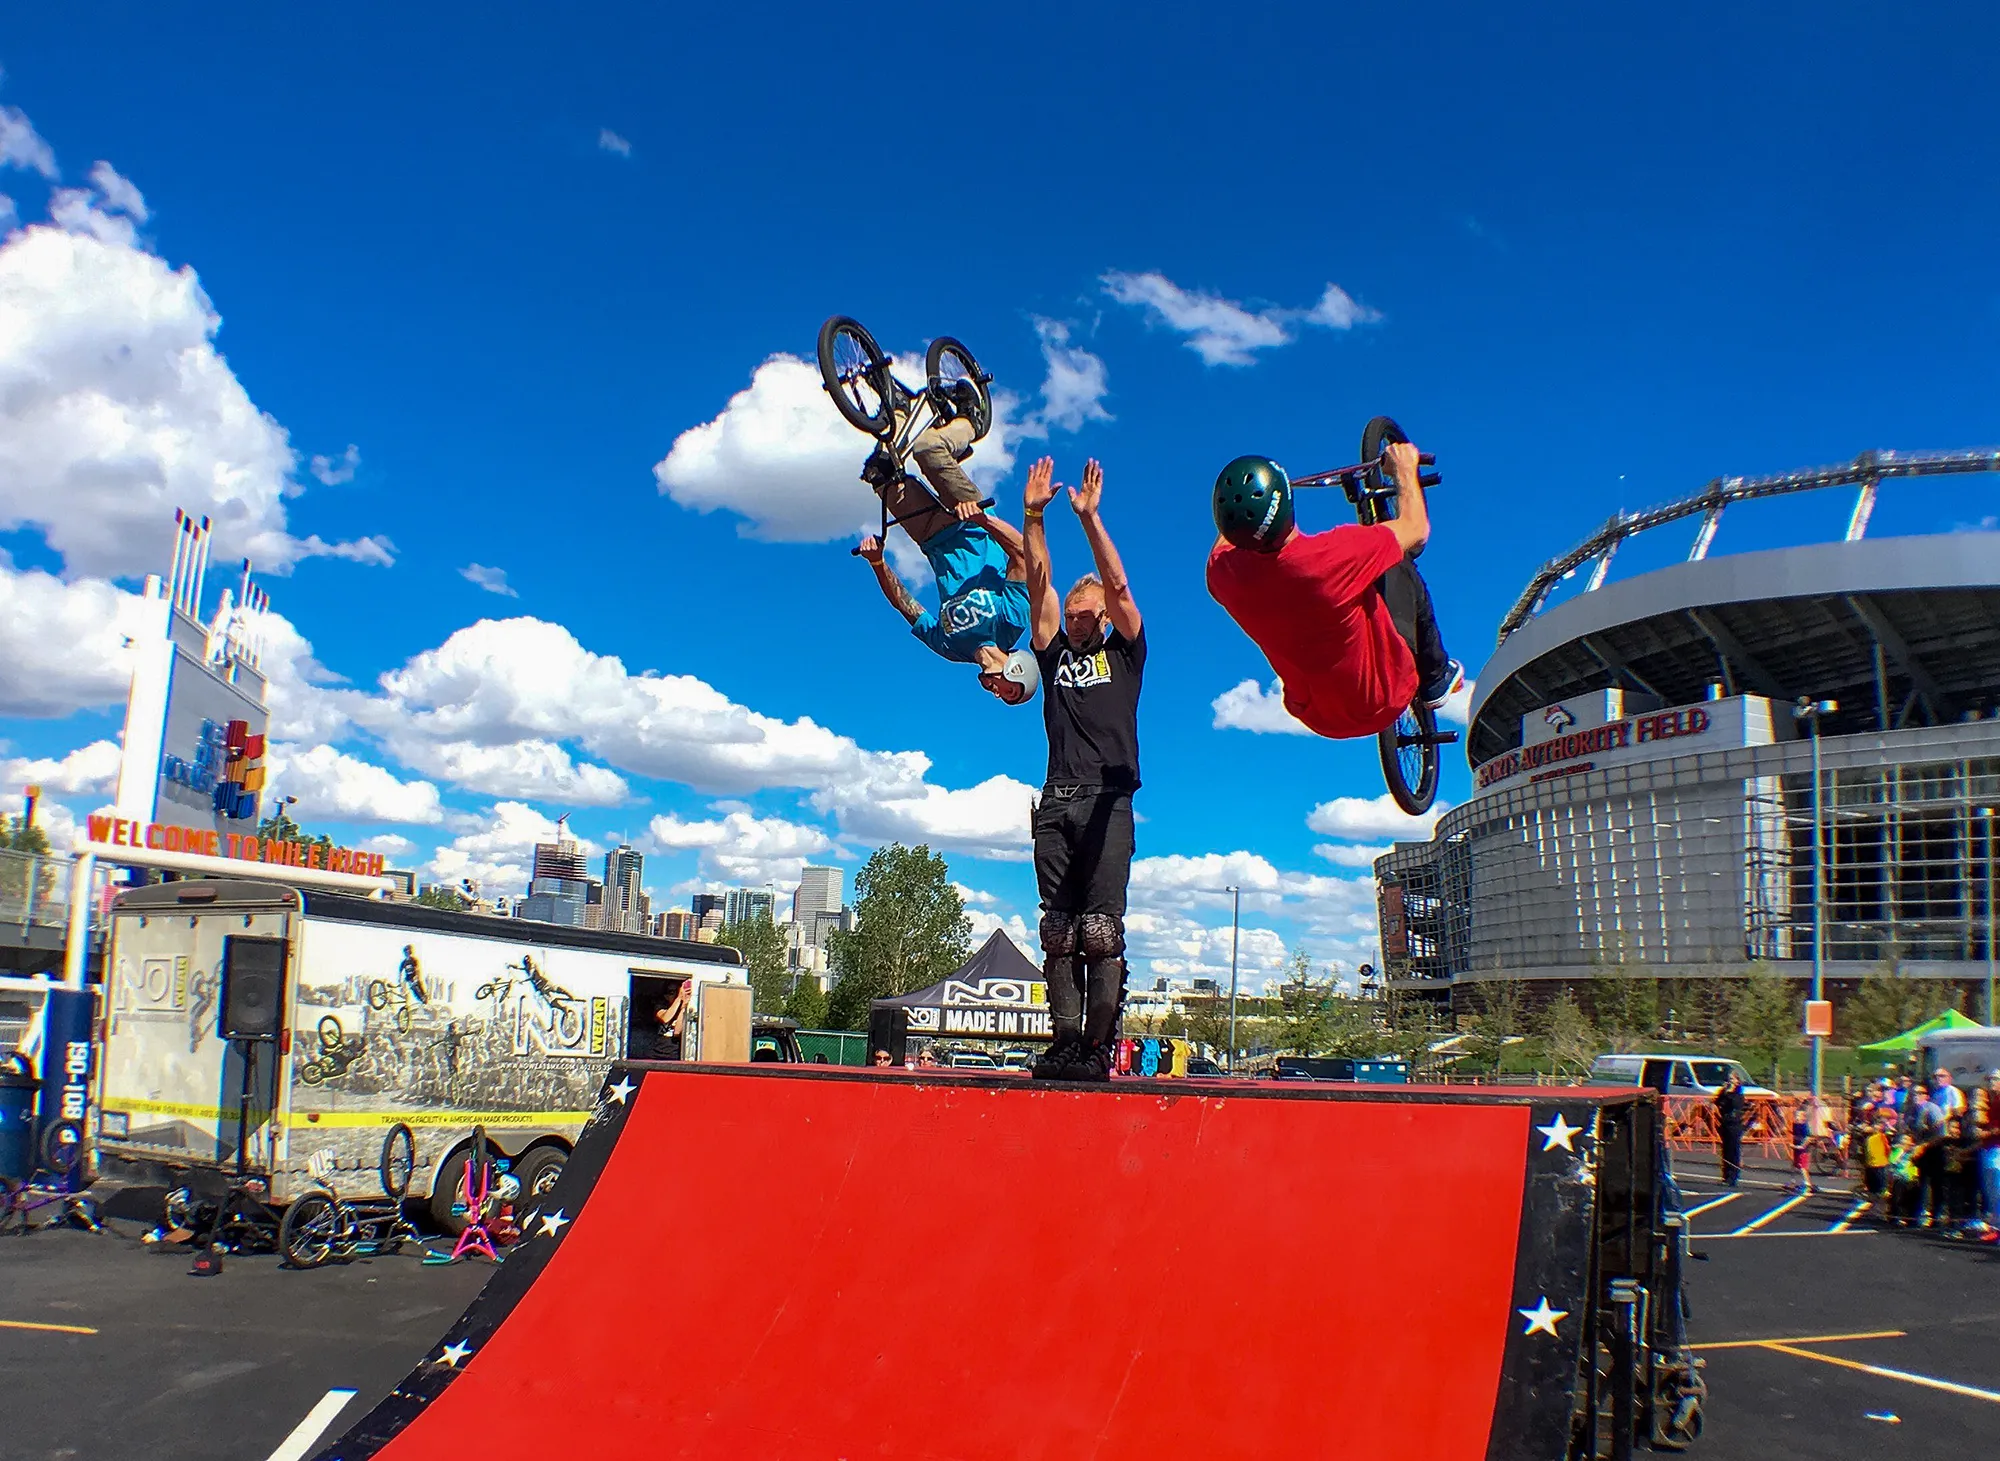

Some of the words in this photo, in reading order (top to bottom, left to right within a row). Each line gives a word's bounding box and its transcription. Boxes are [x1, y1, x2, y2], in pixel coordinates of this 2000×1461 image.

[1520, 721, 1629, 771] AUTHORITY
[1636, 707, 1708, 743] FIELD
[87, 814, 218, 857] WELCOME
[226, 833, 259, 862] TO
[264, 839, 321, 870] MILE
[326, 847, 384, 877] HIGH
[943, 978, 1025, 1004] NO
[591, 997, 605, 1053] WEAR
[945, 1009, 996, 1033] MADE
[999, 1011, 1018, 1034] IN
[1021, 1012, 1053, 1035] THE
[62, 1041, 89, 1120] 801-061
[58, 1128, 78, 1143] P
[381, 1115, 415, 1124] TRAINING
[415, 1115, 443, 1124] FACILITY
[449, 1115, 483, 1124] AMERICAN
[483, 1115, 501, 1123] MADE
[502, 1115, 533, 1123] PRODUCTS
